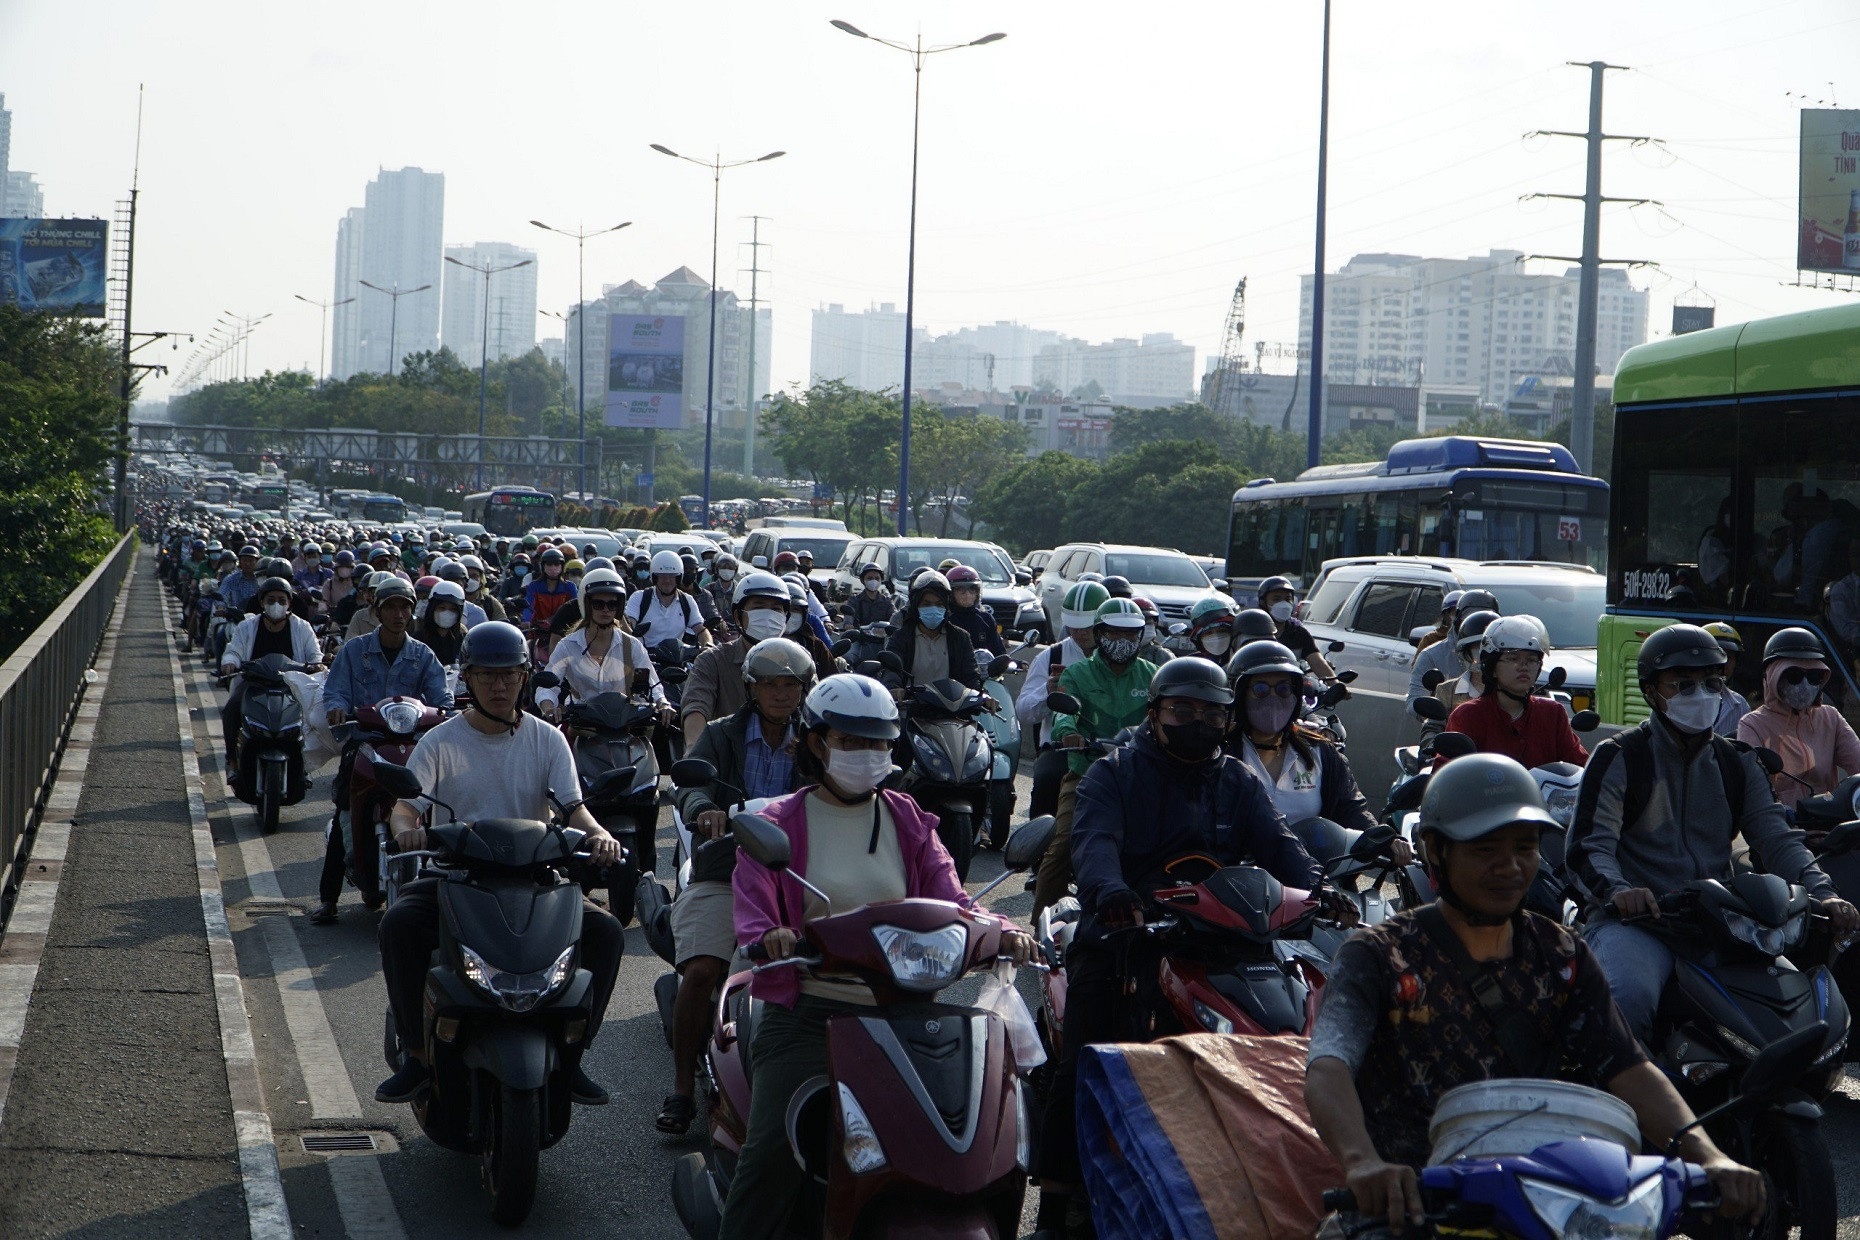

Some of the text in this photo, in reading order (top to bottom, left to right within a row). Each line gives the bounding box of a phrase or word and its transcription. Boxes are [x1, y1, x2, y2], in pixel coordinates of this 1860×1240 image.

[74, 230, 101, 239] CHILL
[66, 239, 93, 248] CHILL
[1560, 521, 1579, 541] 53
